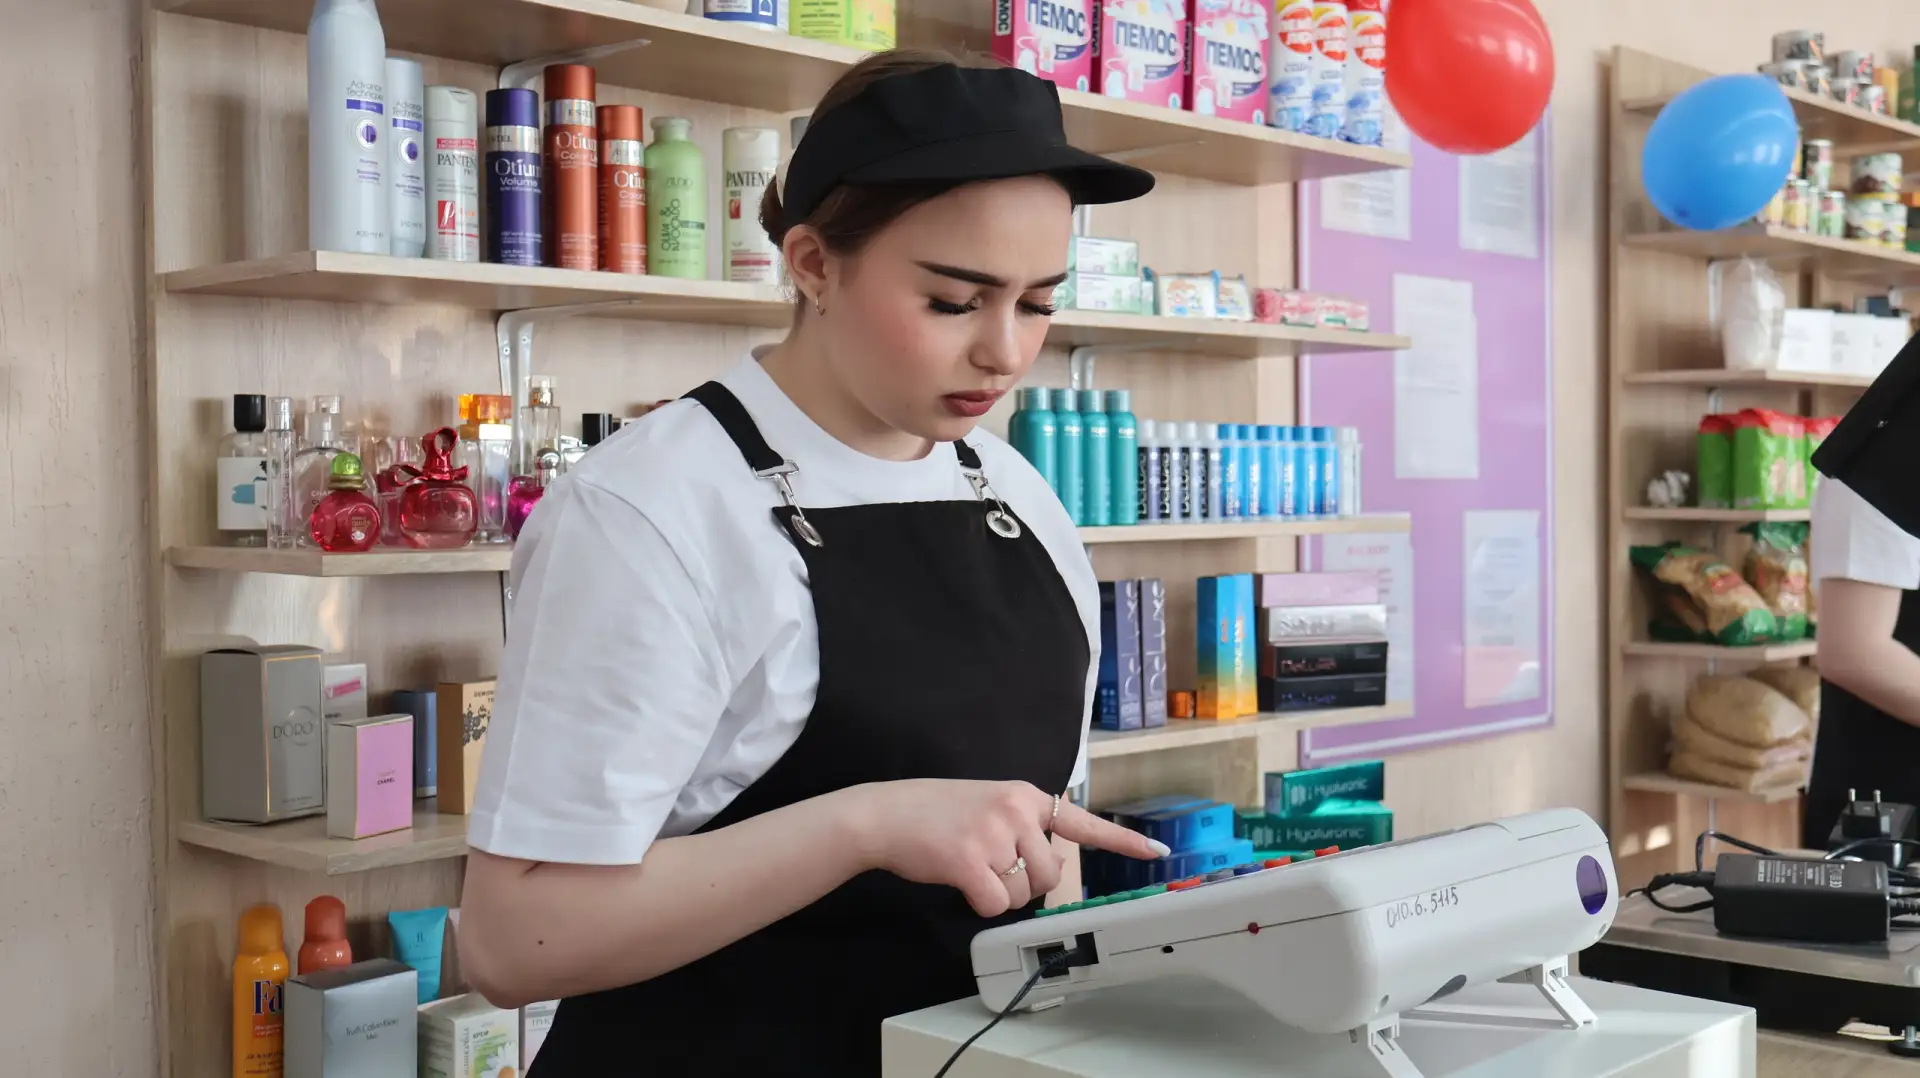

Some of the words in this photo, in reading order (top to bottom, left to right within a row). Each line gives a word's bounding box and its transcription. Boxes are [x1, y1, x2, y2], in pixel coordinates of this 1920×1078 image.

[1028, 0, 1085, 37] ПЕМОС
[1115, 20, 1177, 57] ПЕМОС
[1206, 40, 1261, 74] ПЕМОС
[1314, 777, 1368, 796] Hyaluronic
[1286, 827, 1365, 843] Hyaluronic
[253, 980, 283, 1015] Fa
